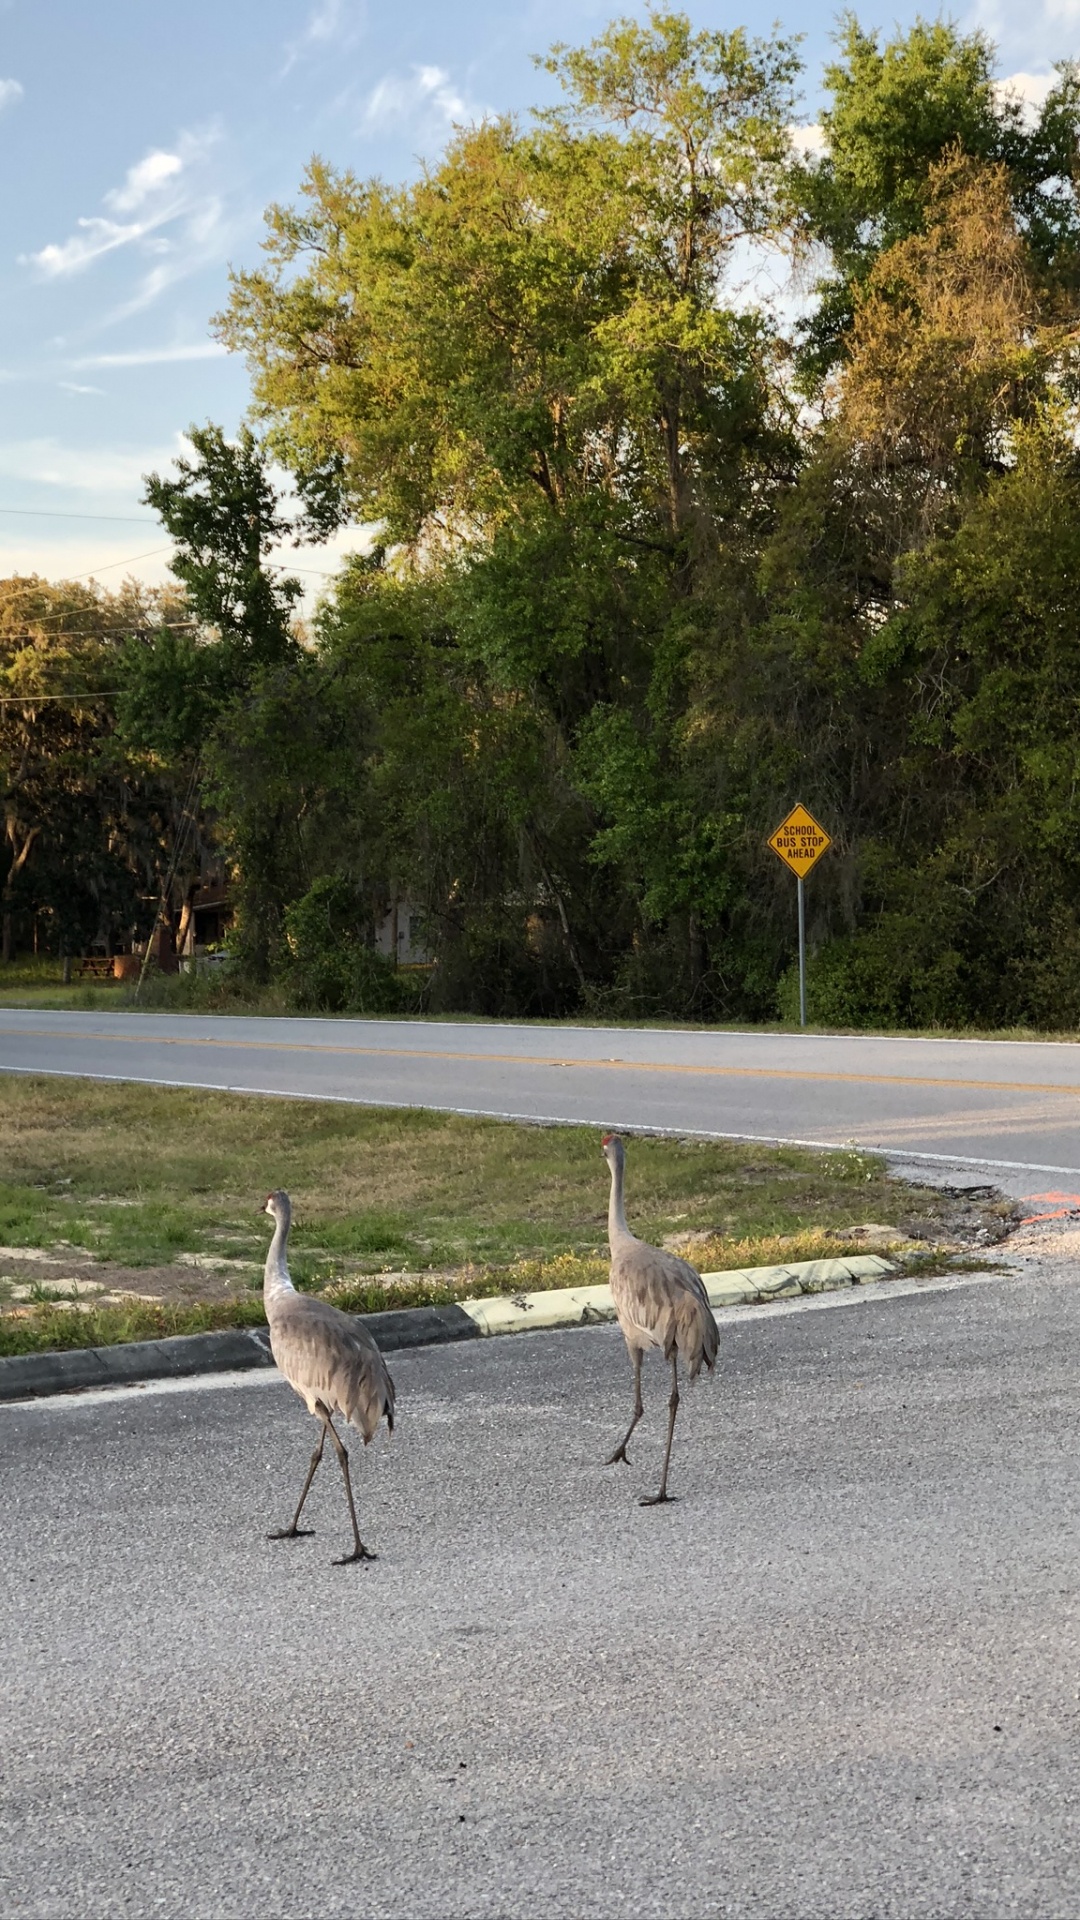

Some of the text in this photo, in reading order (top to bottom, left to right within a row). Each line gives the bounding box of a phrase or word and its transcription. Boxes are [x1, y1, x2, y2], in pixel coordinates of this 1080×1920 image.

[784, 826, 817, 836] SCHOOL
[777, 837, 824, 847] BUS STOP
[787, 848, 815, 858] AHEAD
